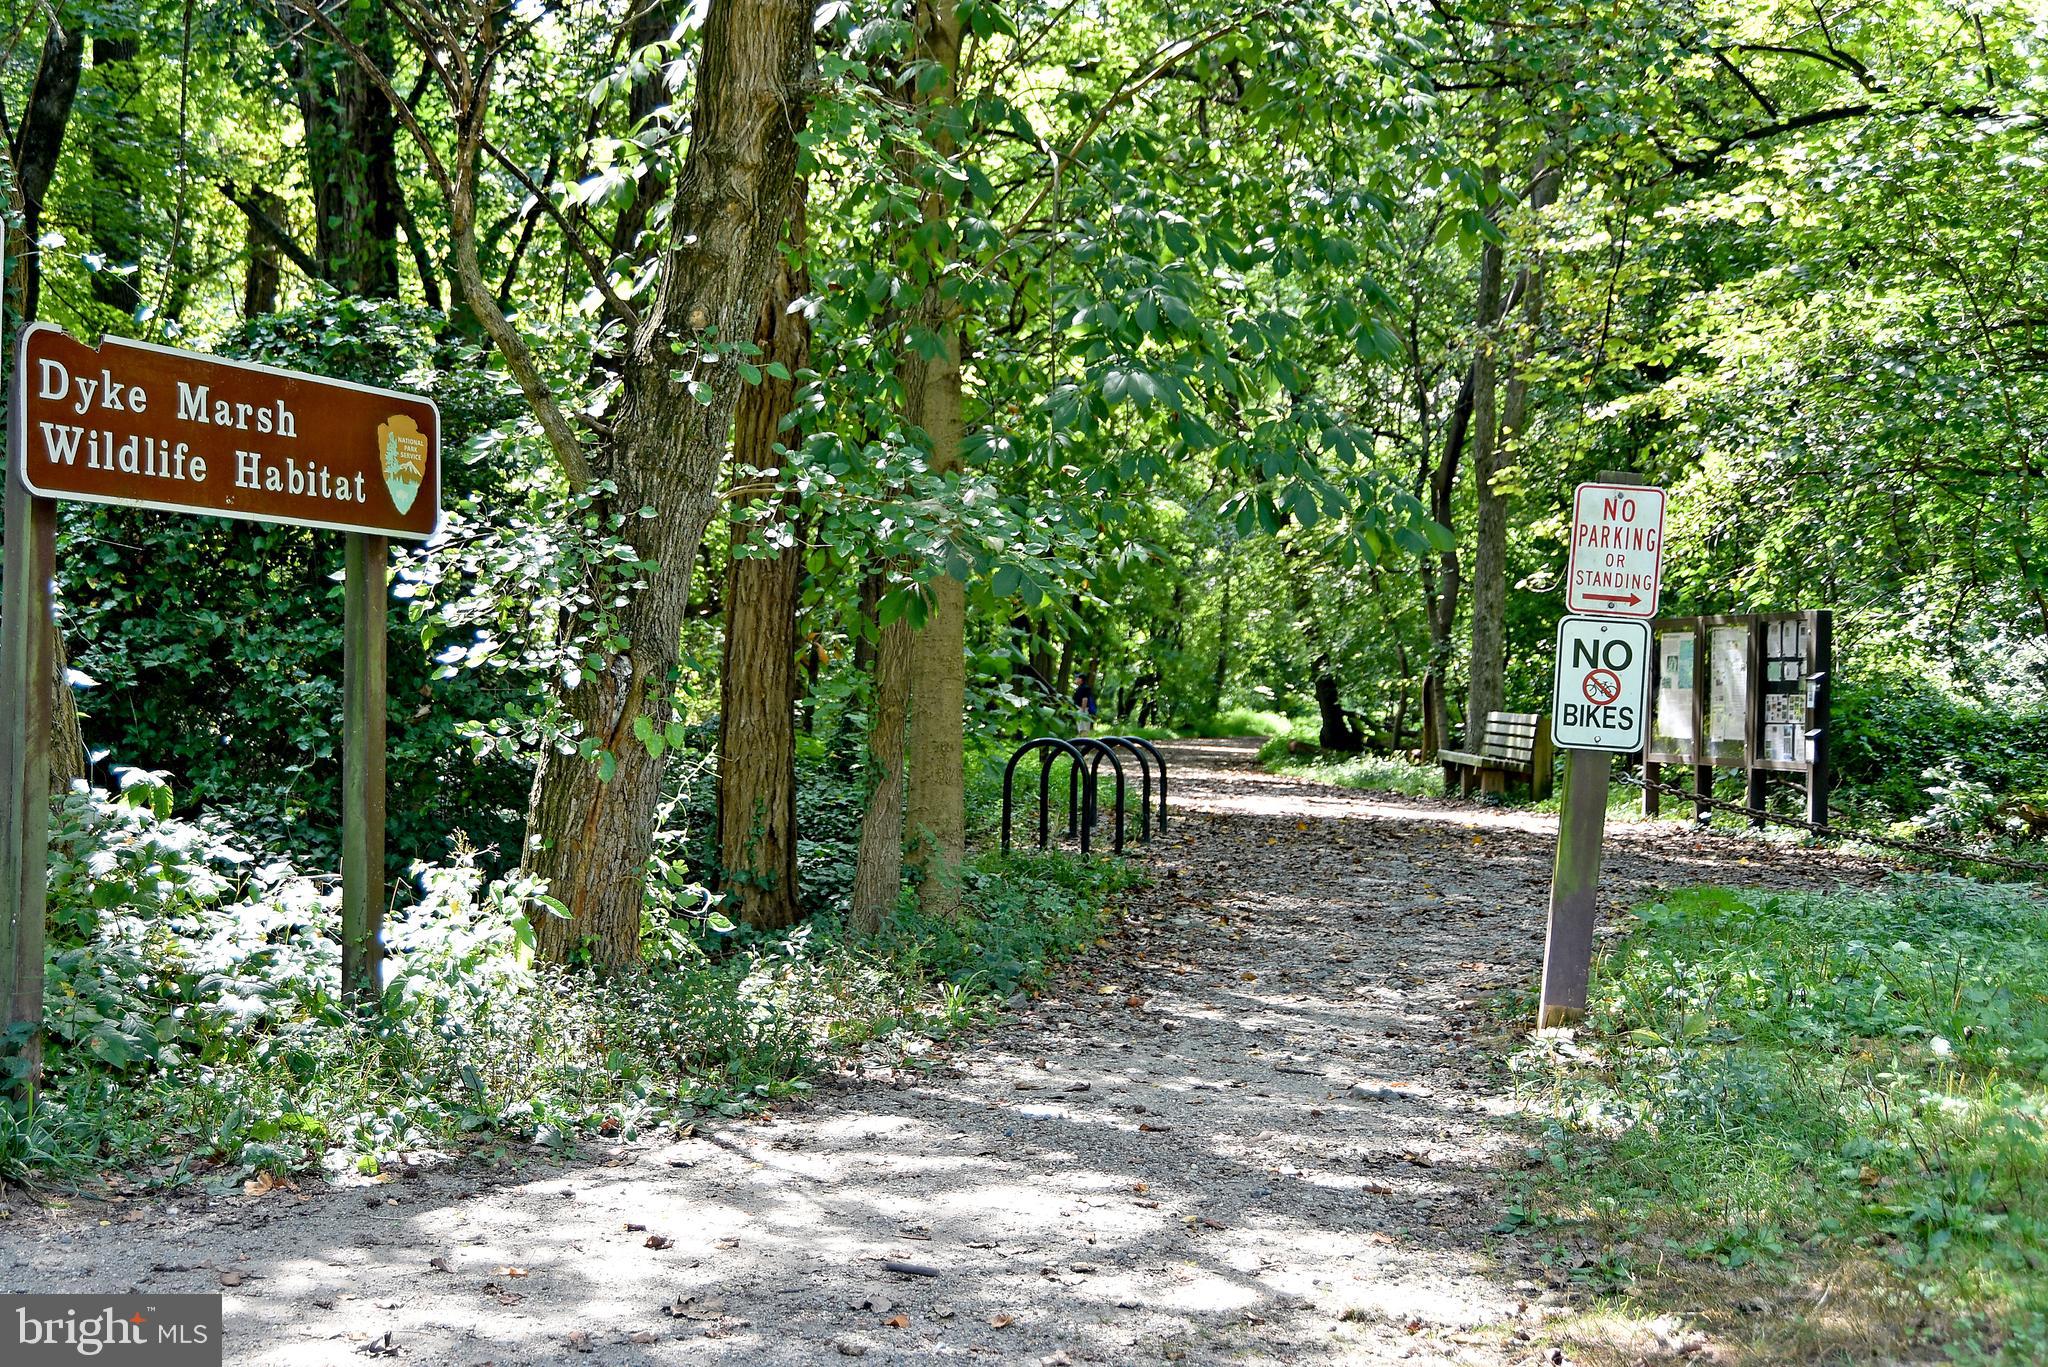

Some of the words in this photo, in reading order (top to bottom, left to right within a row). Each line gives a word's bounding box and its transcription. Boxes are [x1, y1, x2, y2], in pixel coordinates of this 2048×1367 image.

[39, 358, 148, 415] Dyke
[176, 381, 298, 439] Marsh
[397, 436, 424, 446] NATIONAL
[404, 445, 418, 453] PARK
[39, 420, 208, 483] Wildlife
[234, 449, 367, 504] Habitat
[400, 452, 422, 461] SERVICE
[1603, 497, 1637, 523] NO
[1578, 523, 1657, 553] PARKING
[1605, 553, 1626, 568] OR
[1575, 570, 1652, 591] STANDING
[1572, 637, 1634, 672] NO
[1563, 703, 1634, 731] BIKES
